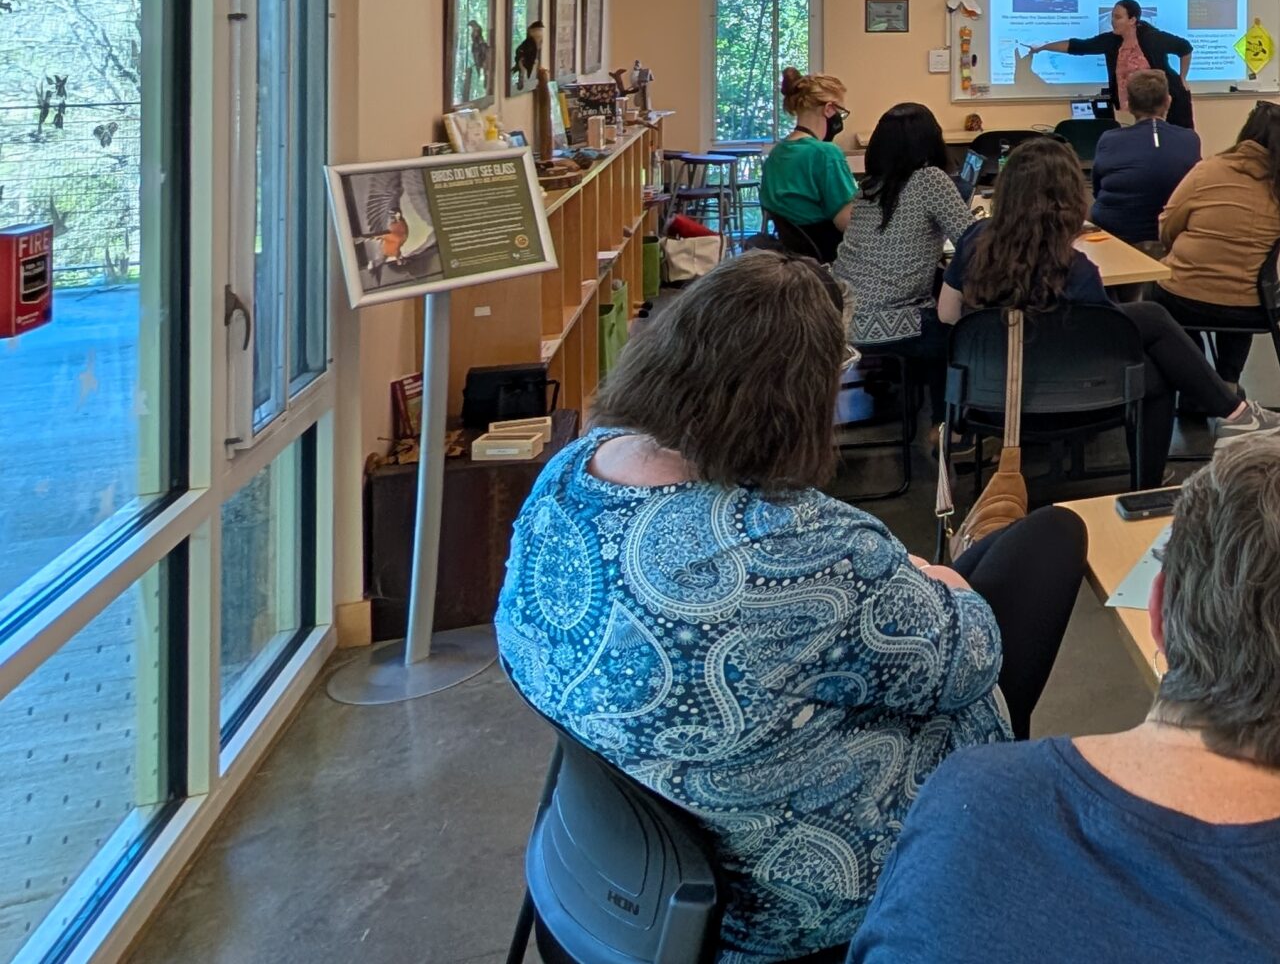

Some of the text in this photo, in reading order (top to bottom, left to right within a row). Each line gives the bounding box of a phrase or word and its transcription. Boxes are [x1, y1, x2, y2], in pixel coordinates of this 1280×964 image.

[430, 163, 516, 183] BIRDS DO NOT SEE GLASS
[18, 229, 50, 258] FIRE
[606, 890, 640, 917] HON
